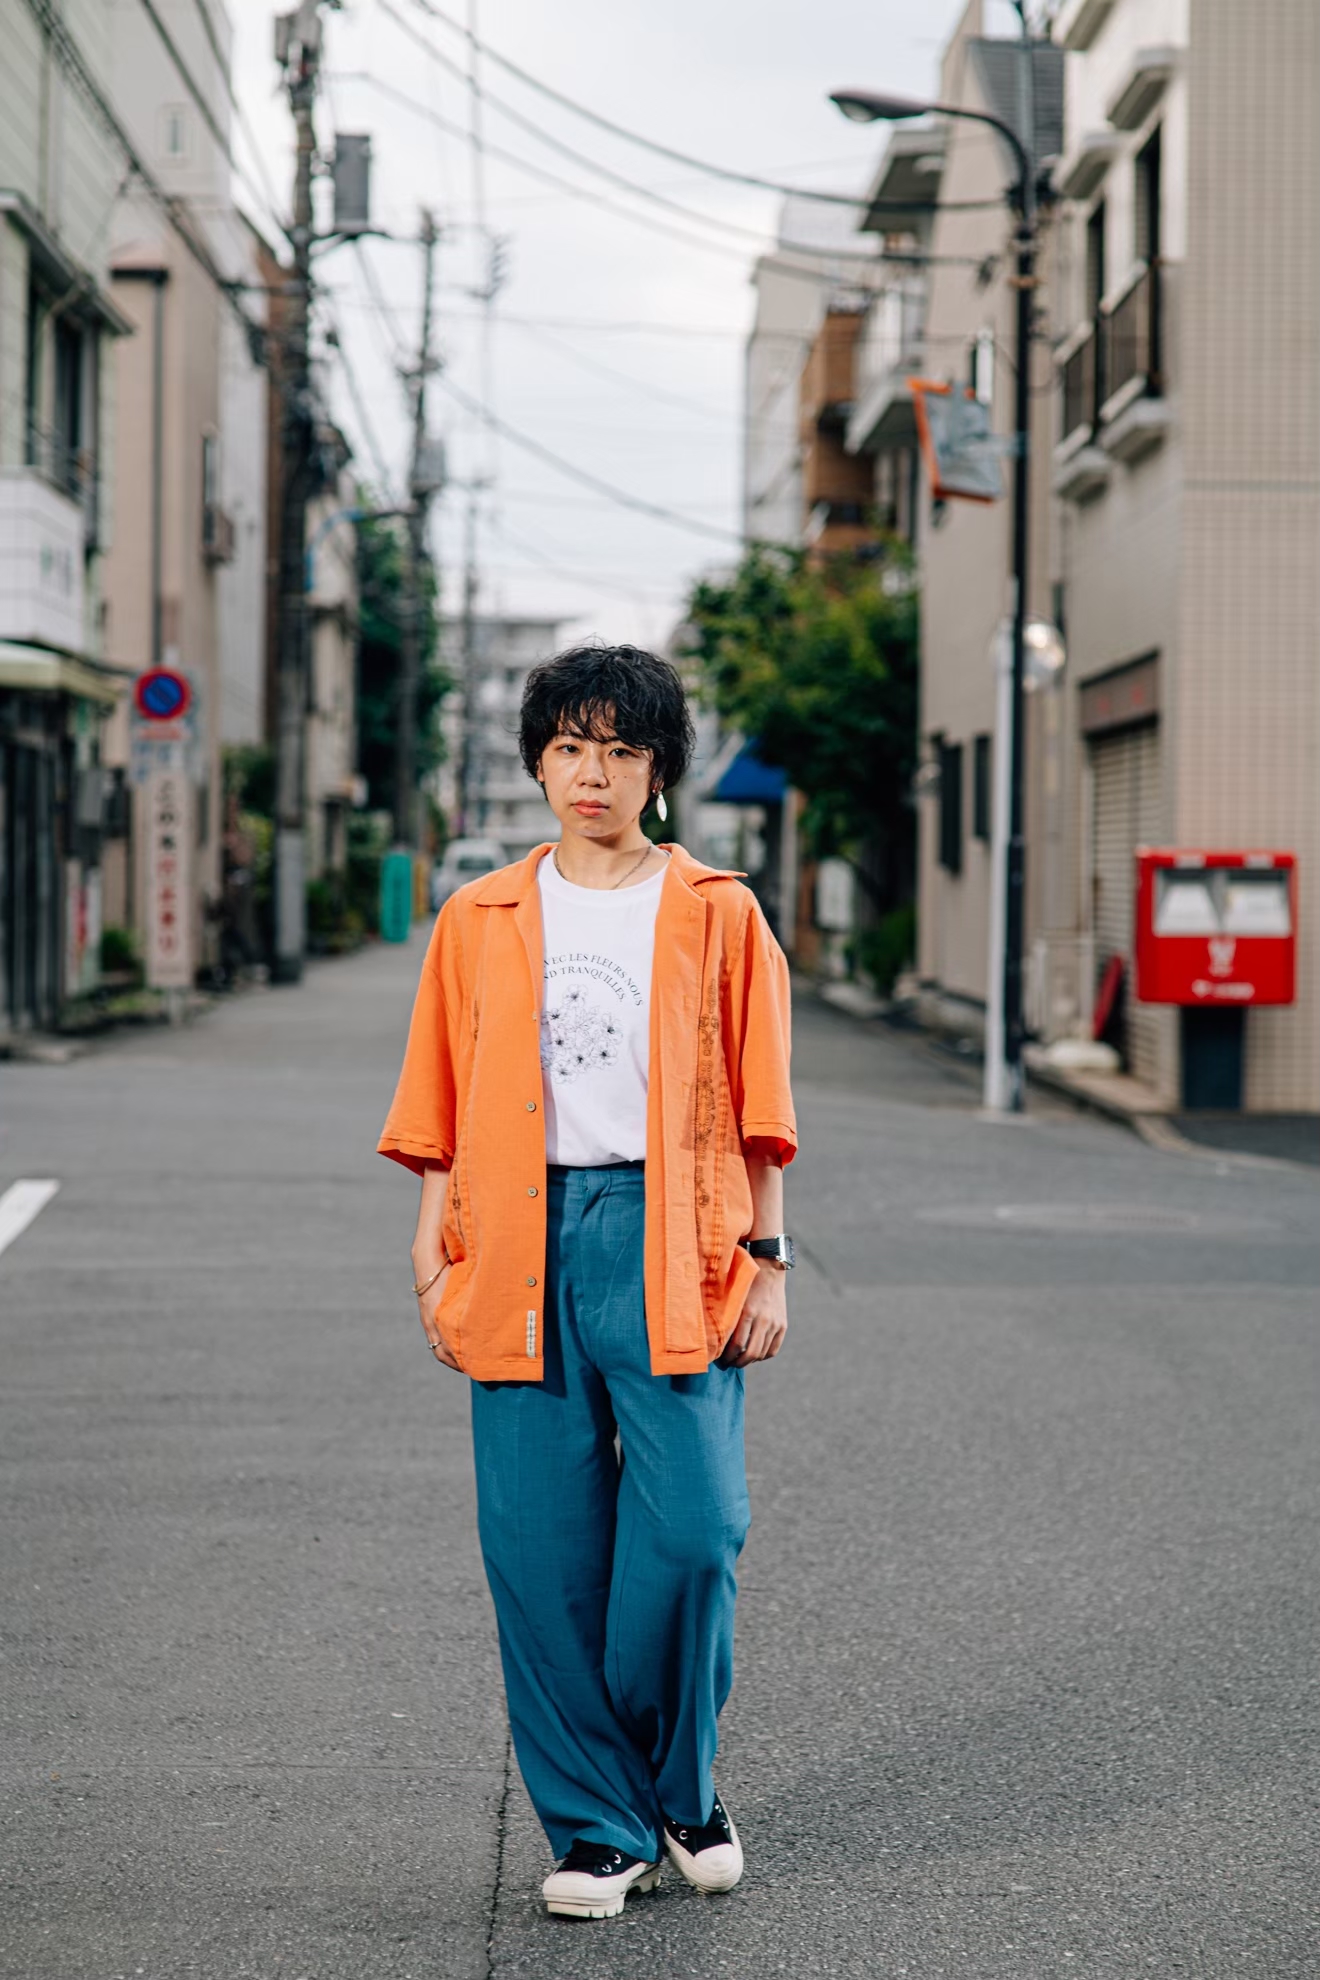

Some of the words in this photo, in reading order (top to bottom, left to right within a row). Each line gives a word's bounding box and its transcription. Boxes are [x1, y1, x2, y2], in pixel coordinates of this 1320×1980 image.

[569, 953, 589, 961] LES
[591, 954, 627, 978] FLEURS
[624, 977, 643, 1006] NOUS
